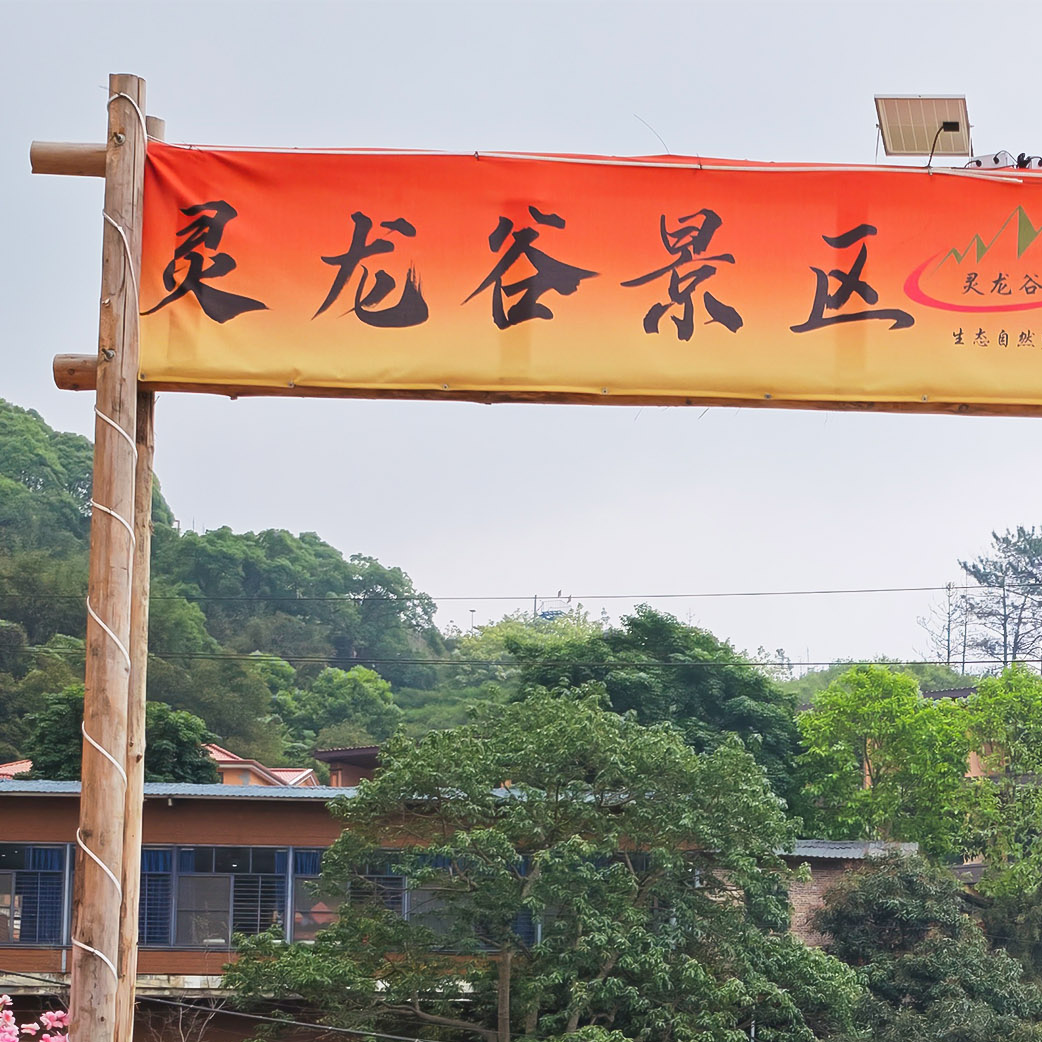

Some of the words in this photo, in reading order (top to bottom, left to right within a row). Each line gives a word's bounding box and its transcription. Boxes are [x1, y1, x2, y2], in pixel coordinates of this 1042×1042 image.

[140, 200, 915, 341] 灵龙谷景区
